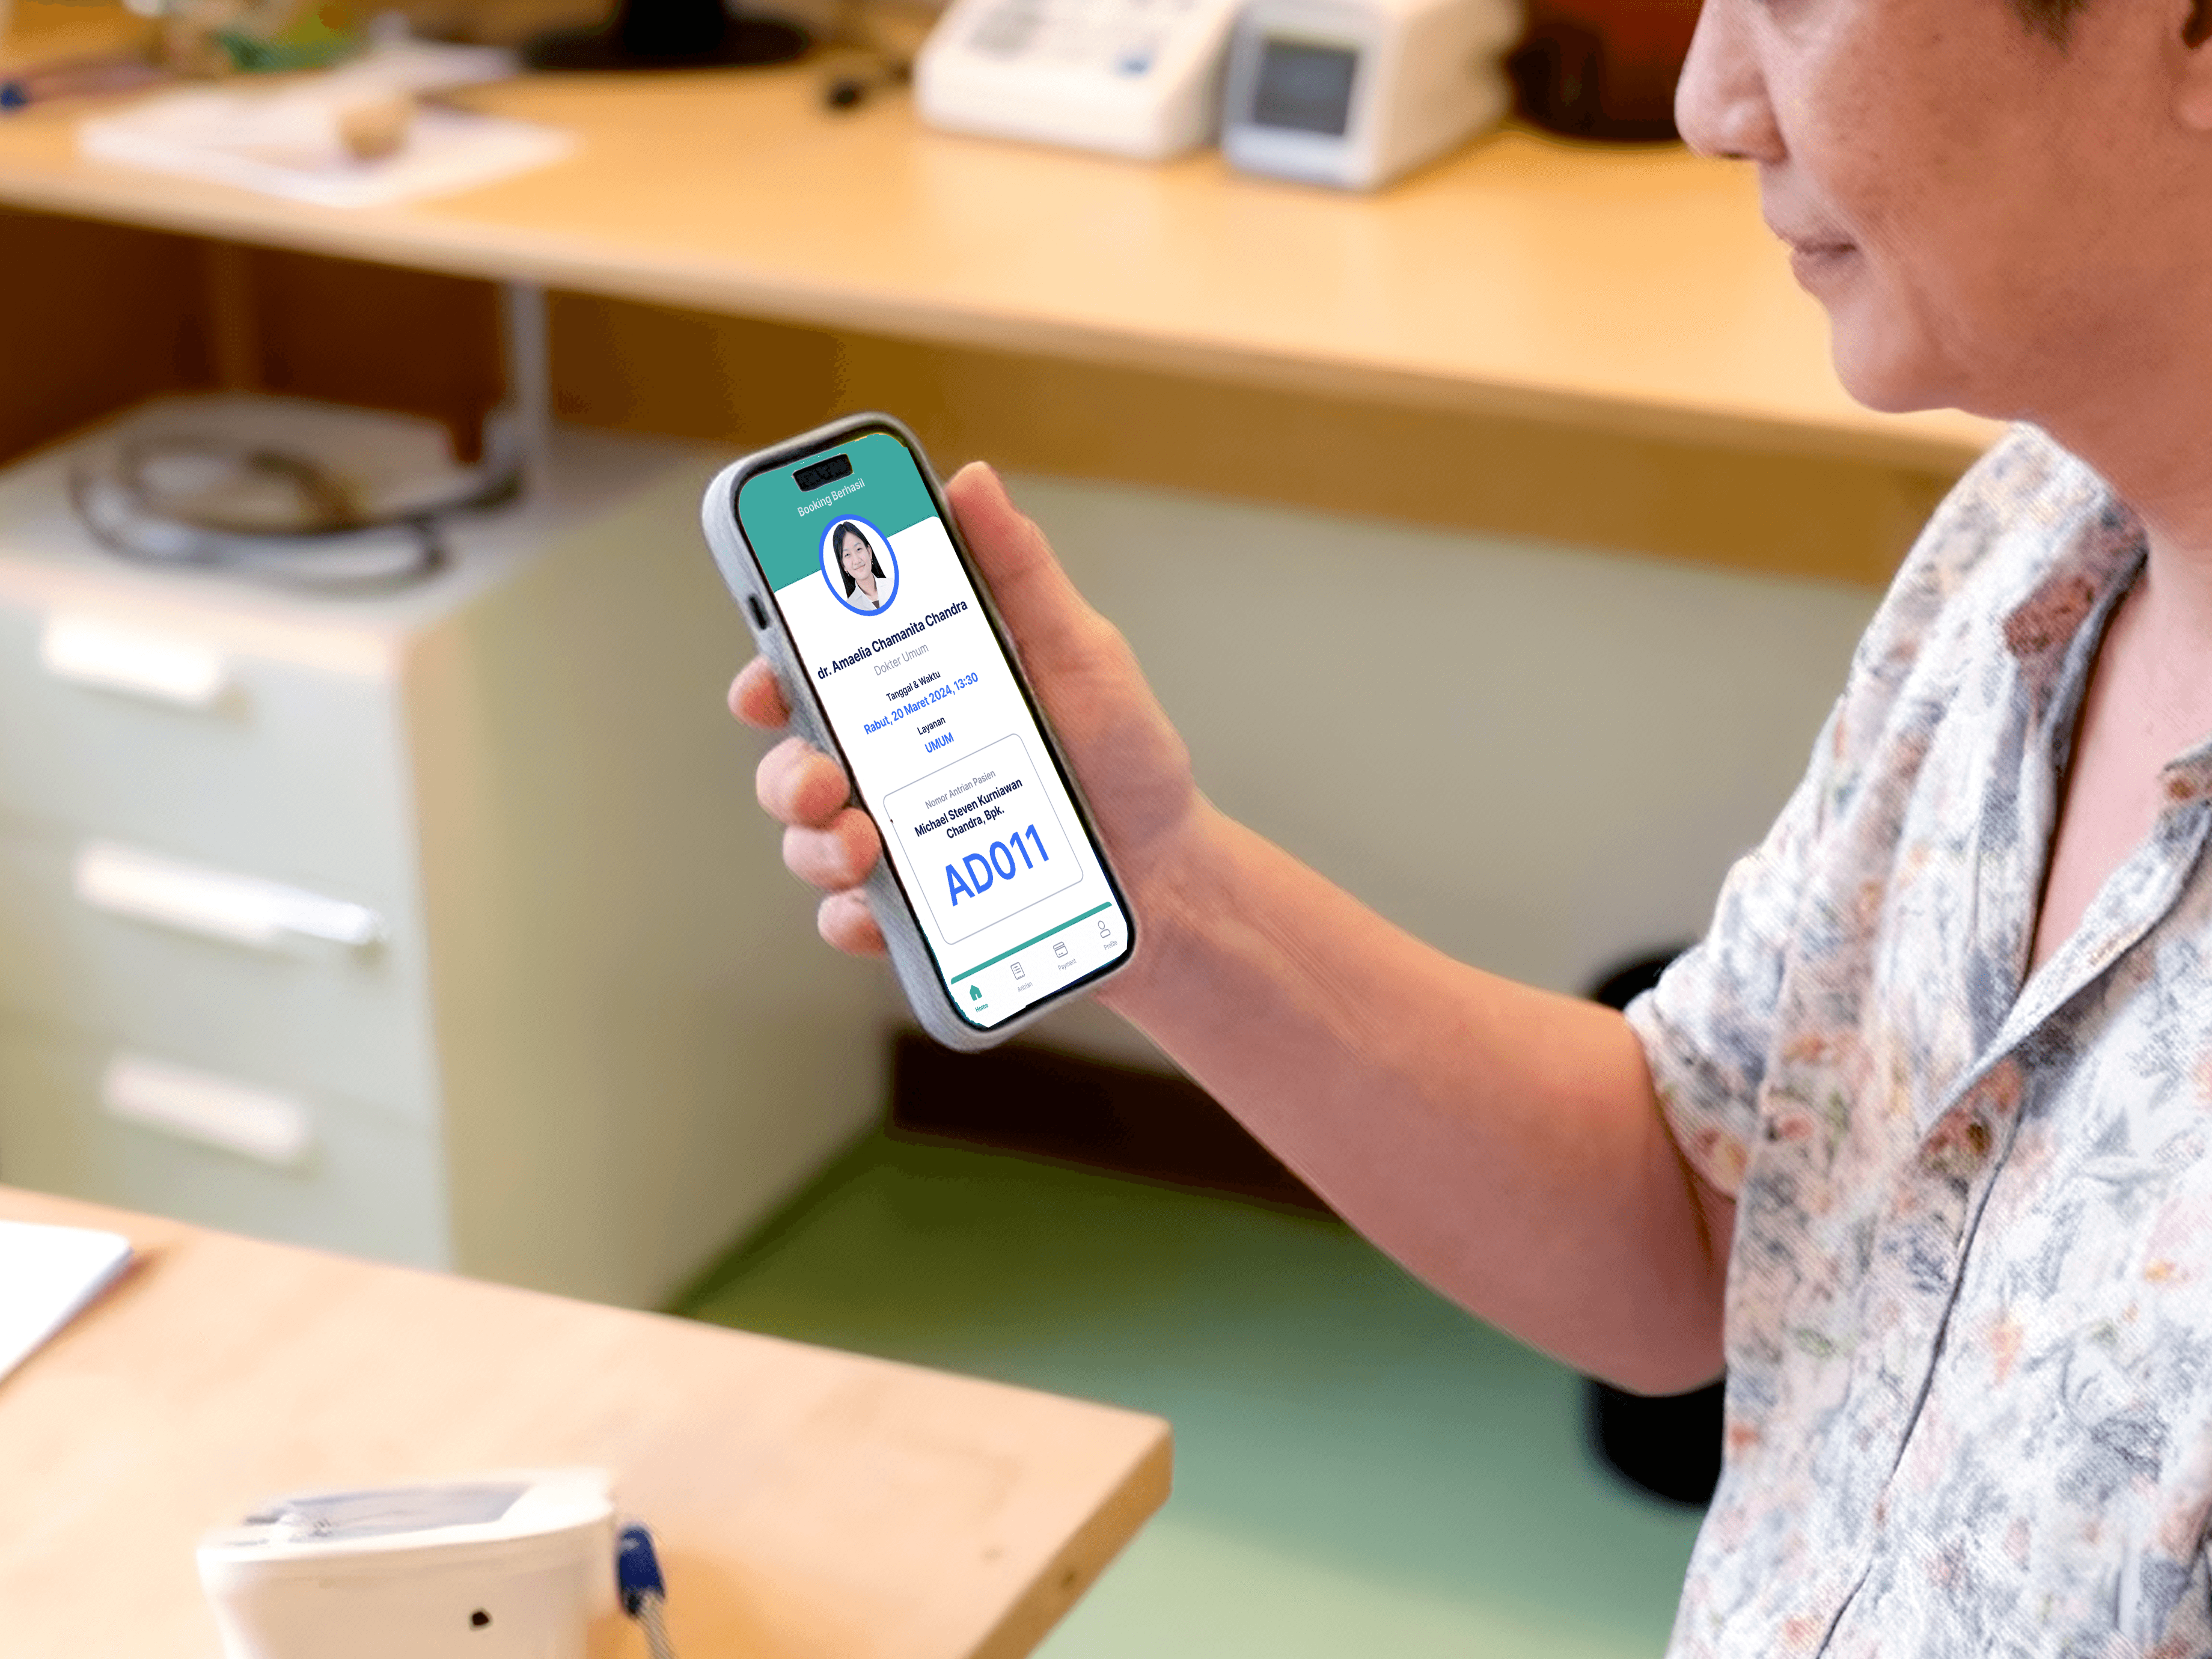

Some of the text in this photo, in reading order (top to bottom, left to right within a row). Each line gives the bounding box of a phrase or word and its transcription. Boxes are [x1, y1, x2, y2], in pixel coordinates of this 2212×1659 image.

[797, 477, 866, 517] Booking Berhasil
[817, 600, 968, 680] dr. Amaelia Chamanita Chandra
[873, 644, 929, 676] Dokter Umum
[885, 671, 941, 701] Tanggal & Waktu
[863, 672, 979, 735] Rabut, 20 Maret 2024, 13:30
[917, 717, 946, 736] Layanan
[924, 732, 955, 753] UMUM
[924, 770, 997, 810] Nomor Antrian Pasien
[914, 779, 1023, 837] Michael Steven Kurniawan
[946, 805, 1005, 839] Chandra, Bpk.
[945, 823, 1049, 907] AD011
[1104, 939, 1118, 950] Profile
[1057, 958, 1077, 971] Payment
[1017, 981, 1033, 992] Antrian
[974, 1003, 989, 1013] Home
